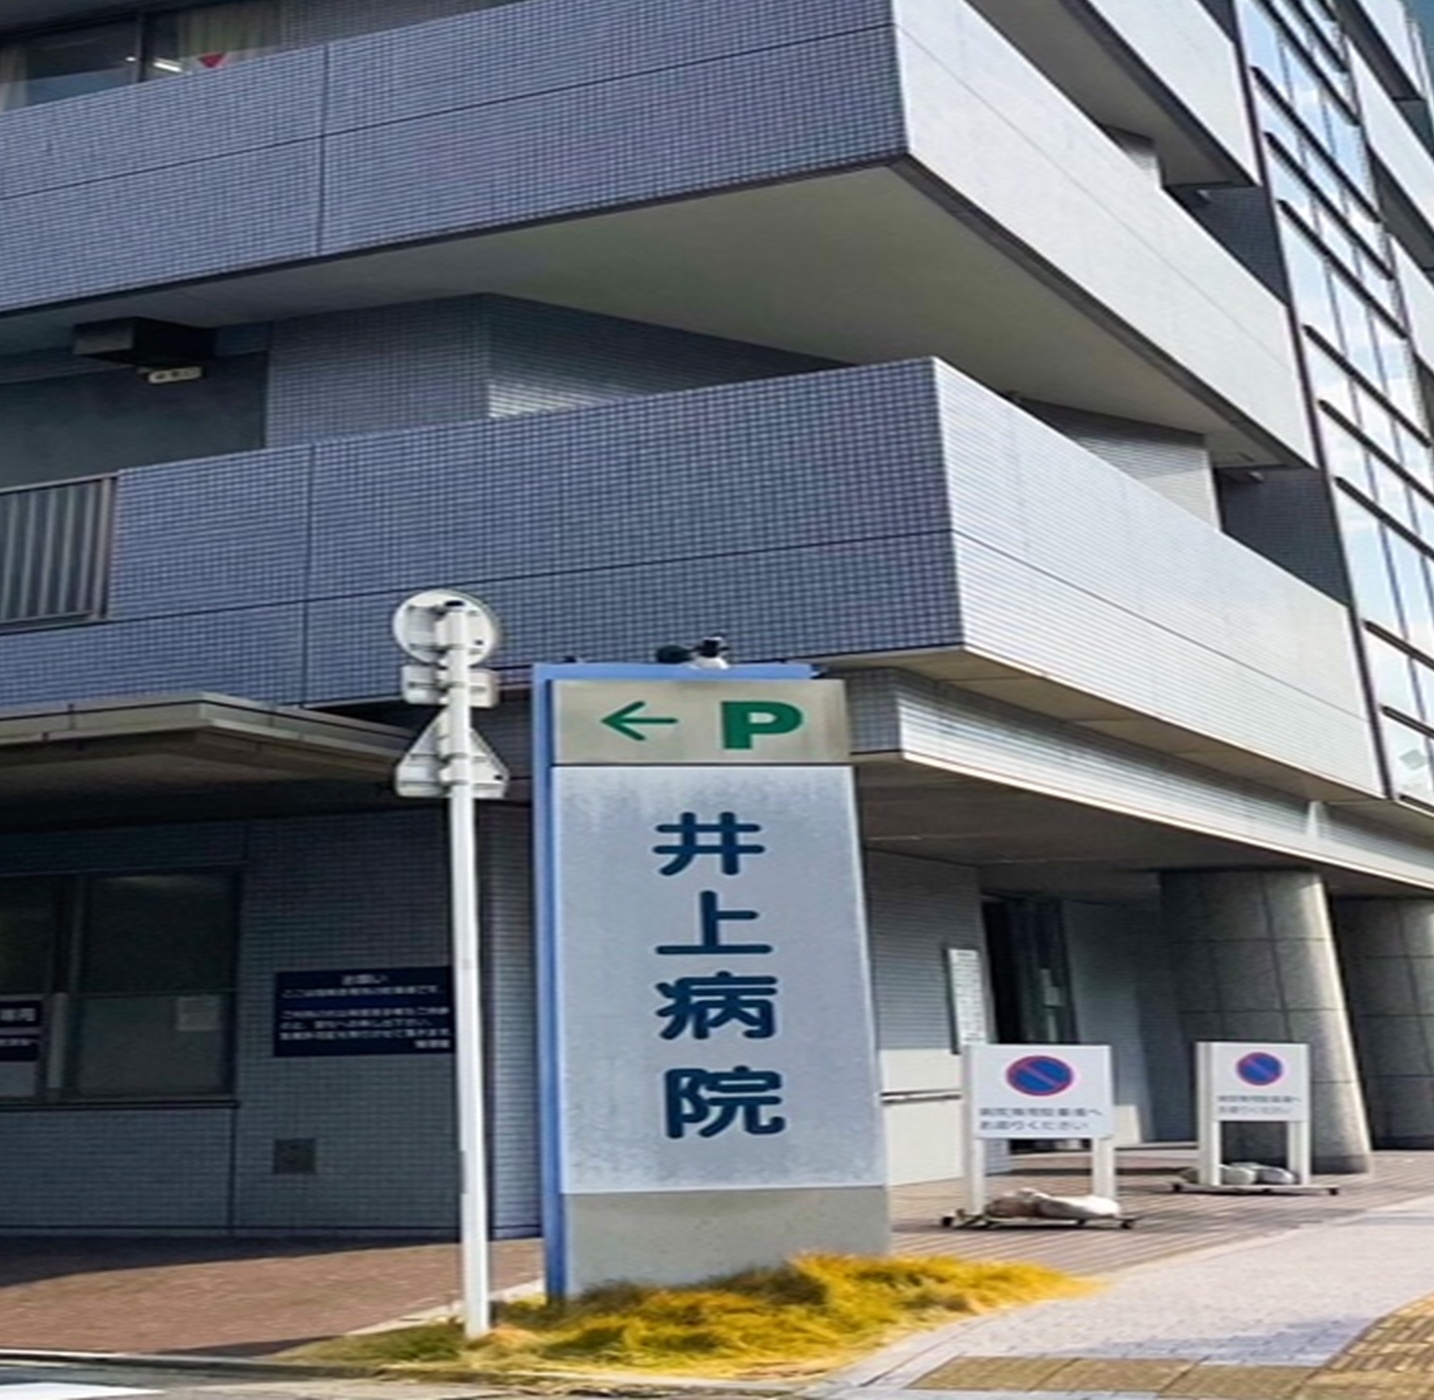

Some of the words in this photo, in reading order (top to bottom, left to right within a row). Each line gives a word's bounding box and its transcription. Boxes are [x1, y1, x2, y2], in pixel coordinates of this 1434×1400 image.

[722, 701, 803, 750] P
[652, 811, 785, 1139] 井上病院
